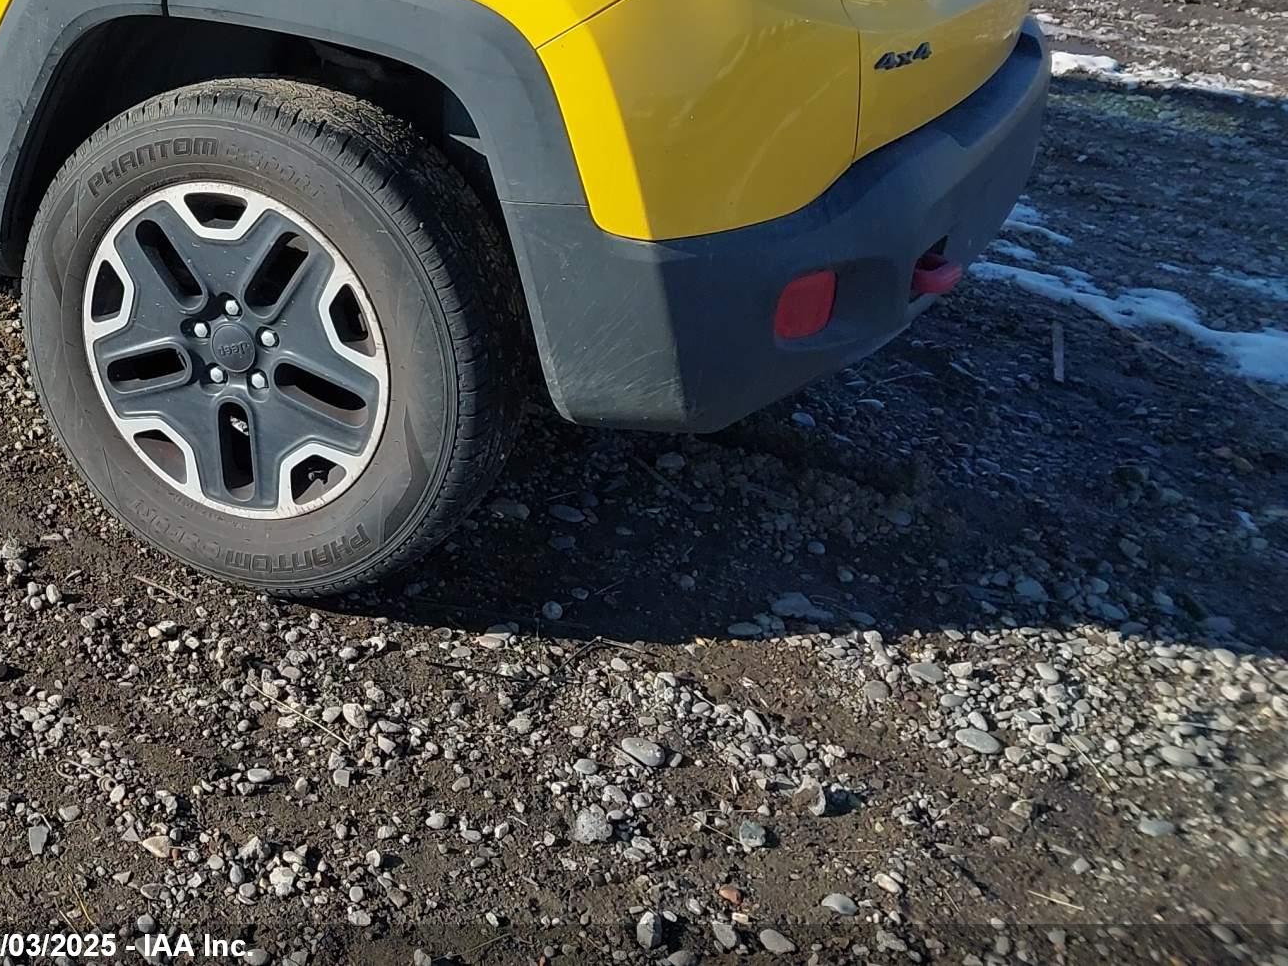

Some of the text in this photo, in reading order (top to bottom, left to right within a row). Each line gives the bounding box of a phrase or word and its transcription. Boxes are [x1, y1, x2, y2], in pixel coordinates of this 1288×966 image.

[874, 41, 932, 70] 4x4
[87, 136, 219, 199] PHANTOM
[223, 522, 373, 574] PHANTOM
